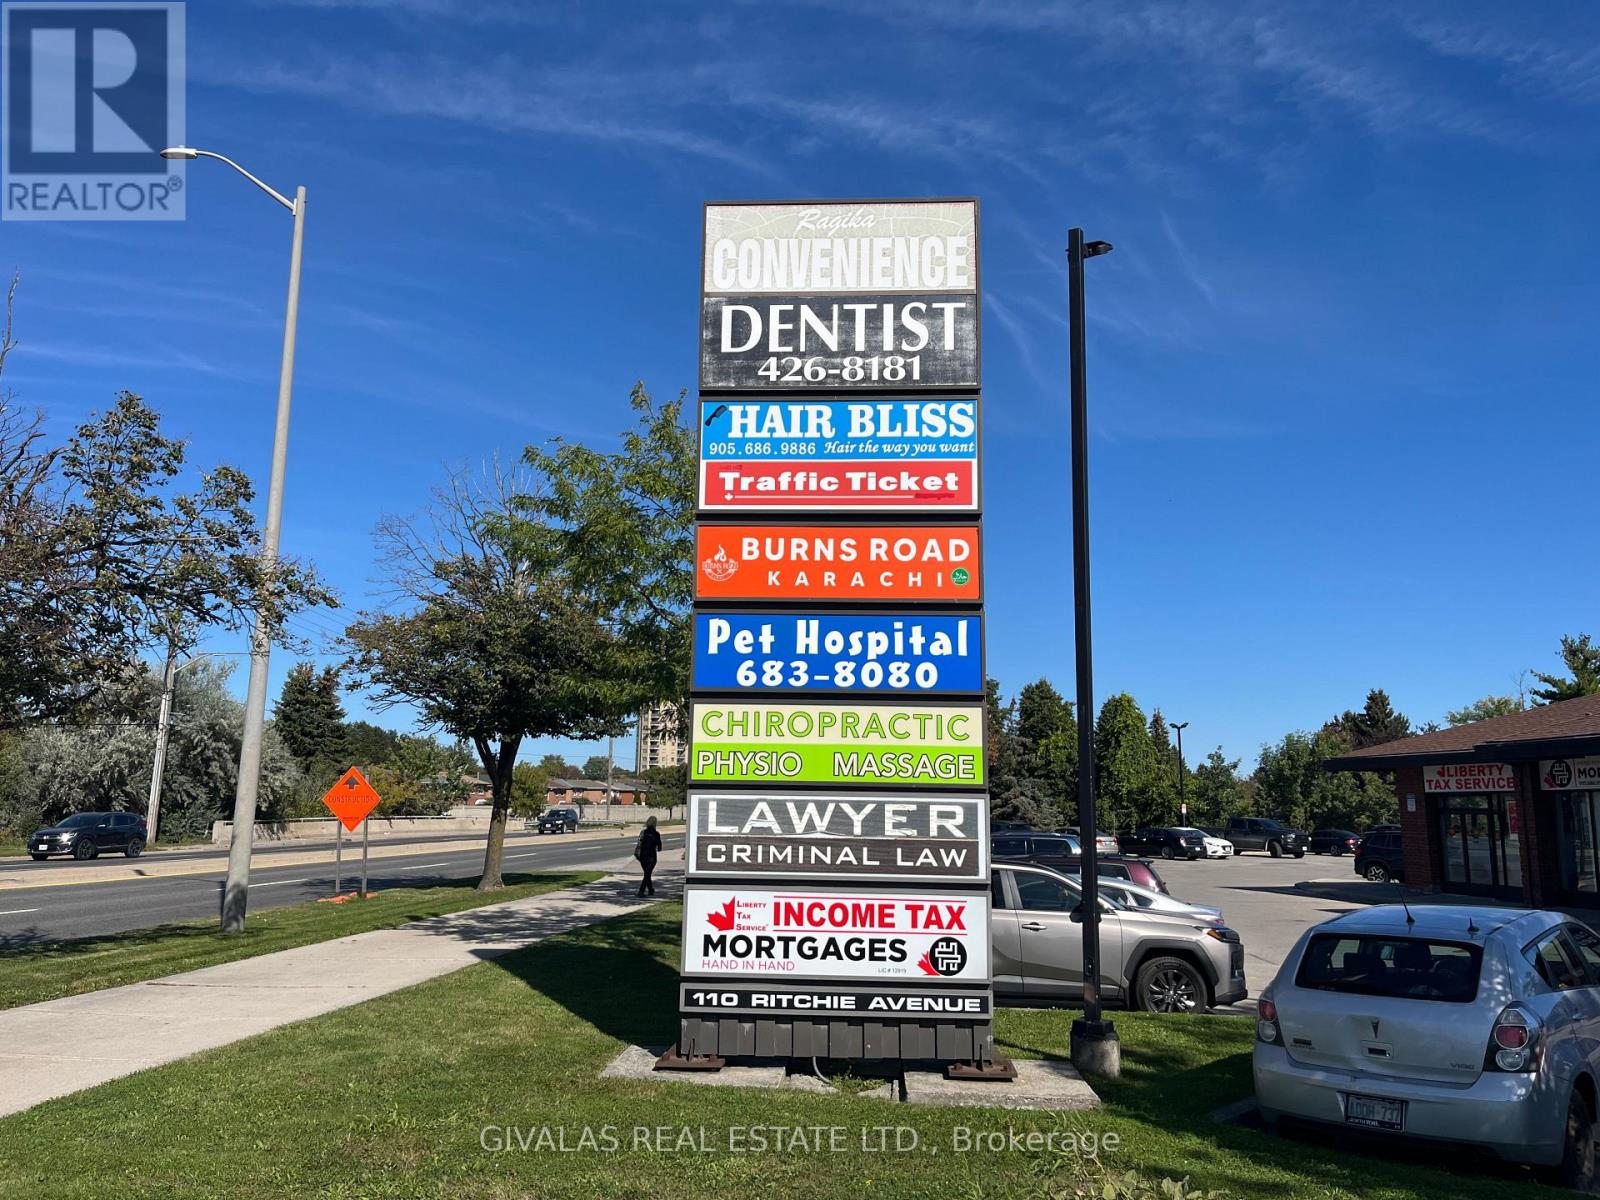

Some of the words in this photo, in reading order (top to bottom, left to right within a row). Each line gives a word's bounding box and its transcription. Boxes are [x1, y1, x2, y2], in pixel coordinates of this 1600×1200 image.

[799, 209, 877, 237] Ragika
[712, 236, 970, 289] CONVENIENCE
[721, 302, 966, 352] DENTIST
[757, 355, 921, 382] 426-8181
[728, 405, 835, 439] HAIR
[848, 403, 974, 438] BLISS
[709, 443, 816, 455] 905.686.9886
[824, 441, 855, 453] Hair
[858, 440, 879, 453] the
[882, 443, 910, 456] way
[911, 443, 936, 456] you
[939, 441, 974, 453] want
[719, 472, 839, 491] Traffic
[845, 472, 959, 491] Ticket
[742, 537, 858, 562] BURNS
[870, 538, 970, 561] ROAD
[768, 571, 942, 587] KARACHI
[707, 618, 775, 655] Pet
[796, 619, 968, 660] Hospital
[736, 659, 938, 689] 683-8080
[702, 711, 970, 742] CHIROPRACTIC
[697, 750, 803, 776] PHYSIO
[833, 752, 976, 780] MASSAGE
[1447, 765, 1504, 777] LIBERTY
[1426, 779, 1451, 790] TAX
[1456, 777, 1516, 789] SERVICE
[708, 801, 967, 838] LAWYER
[706, 844, 880, 867] CRIMINAL
[896, 847, 967, 868] LAW
[773, 901, 896, 929] INCOME
[905, 904, 967, 930] TAX
[702, 934, 908, 963] MORTGAGES
[702, 960, 738, 971] HAND
[742, 960, 754, 971] IN
[758, 960, 795, 972] HAND
[692, 992, 739, 1007] 110
[751, 994, 856, 1009] RITCHIE
[867, 996, 981, 1011] AVENUE
